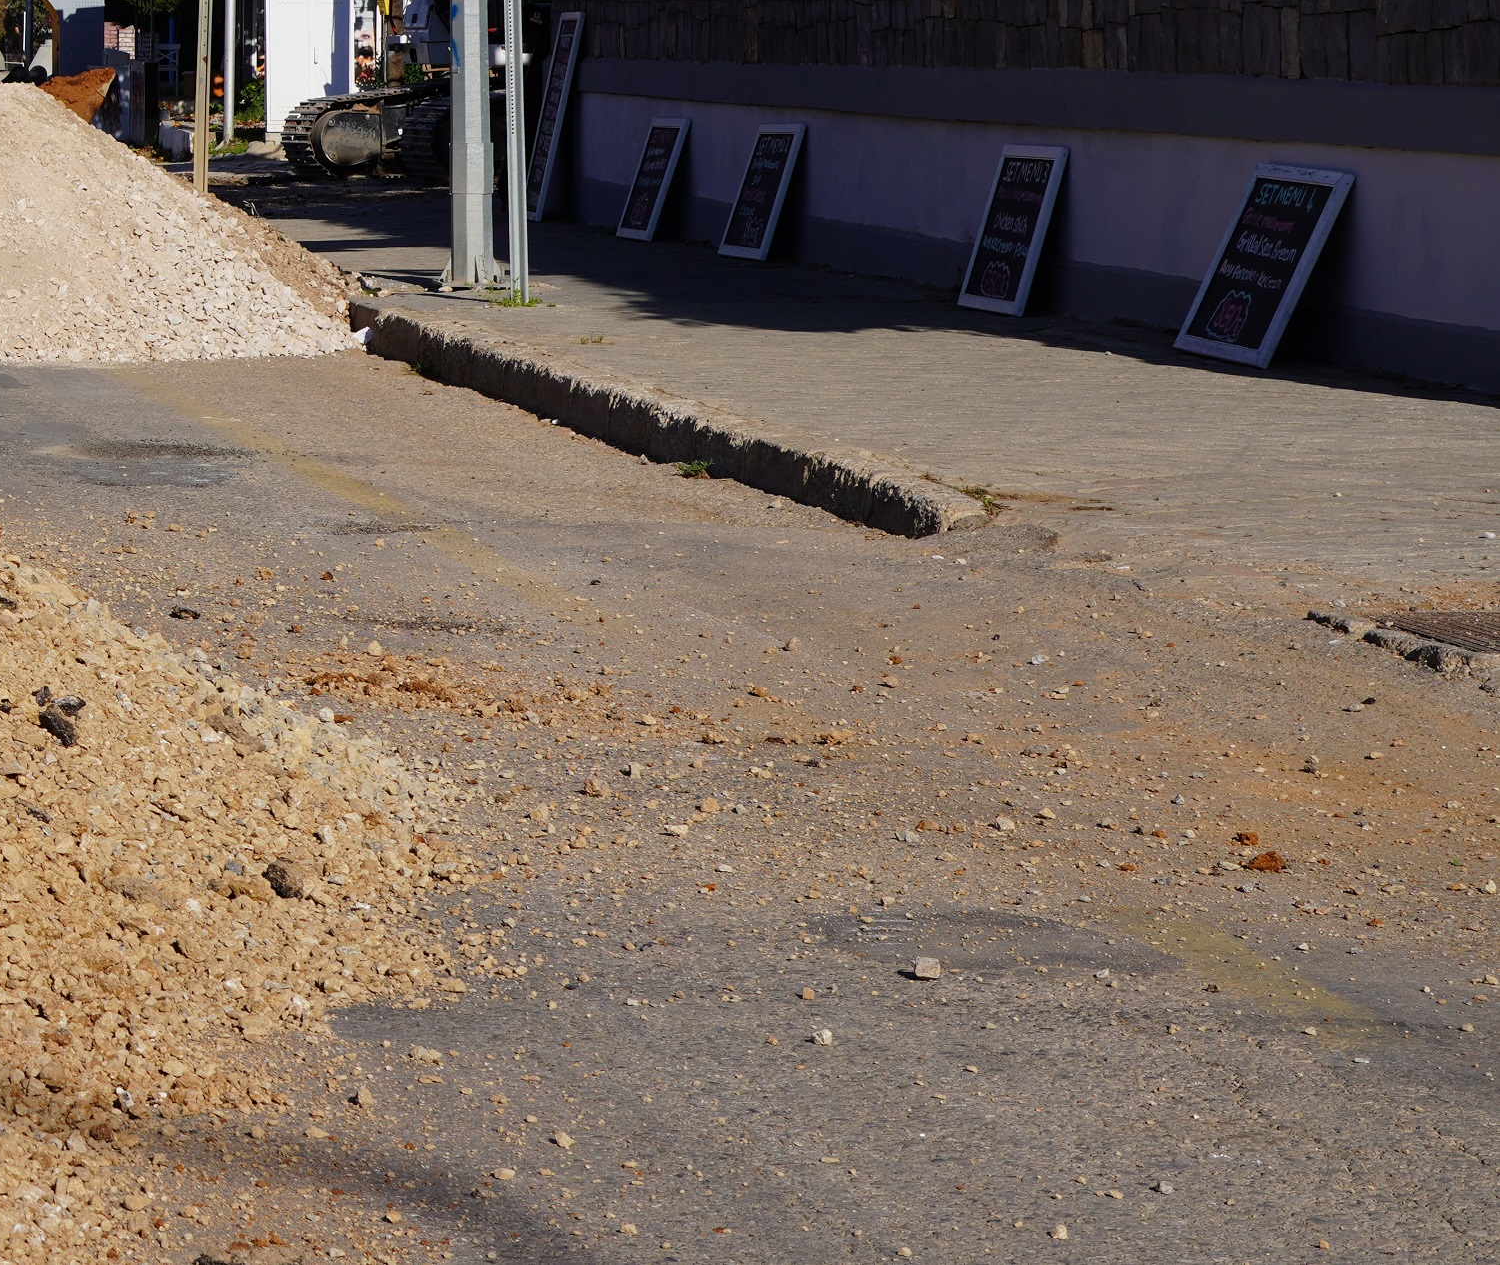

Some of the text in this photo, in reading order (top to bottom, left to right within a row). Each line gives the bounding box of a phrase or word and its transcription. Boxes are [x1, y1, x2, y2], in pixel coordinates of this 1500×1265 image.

[1003, 161, 1021, 183] SET
[1042, 162, 1050, 183] 3
[1255, 183, 1278, 205] SET
[1258, 237, 1274, 257] Sea
[1271, 240, 1297, 263] Bream
